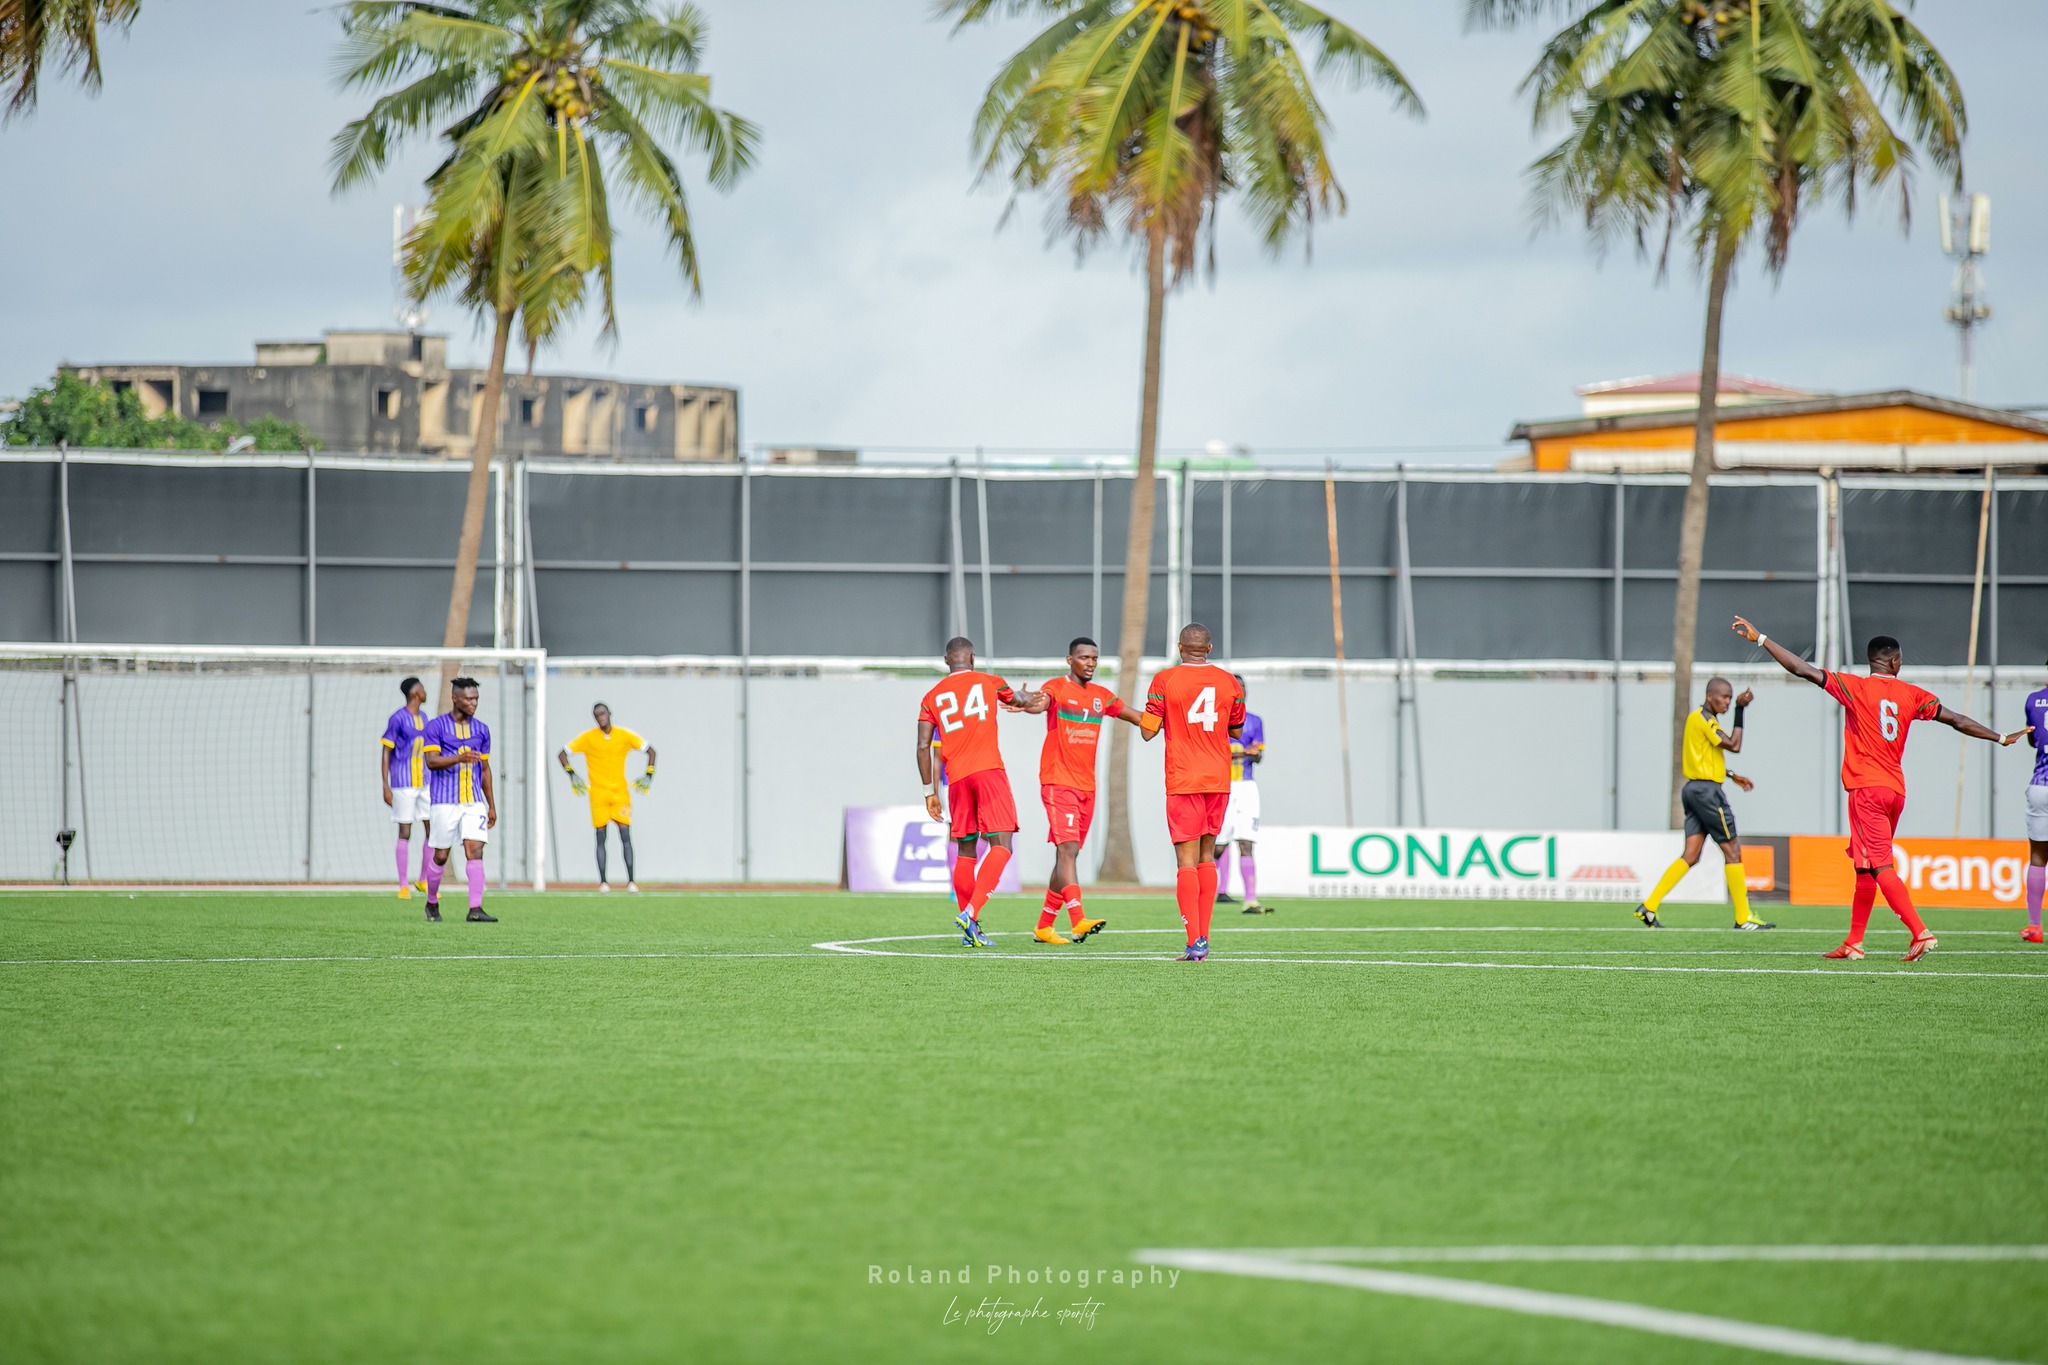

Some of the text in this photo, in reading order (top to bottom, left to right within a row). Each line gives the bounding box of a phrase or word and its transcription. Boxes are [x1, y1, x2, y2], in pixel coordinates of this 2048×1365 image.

[935, 683, 990, 734] 24
[1082, 708, 1089, 722] 7
[1187, 687, 1219, 732] 4
[1878, 698, 1899, 742] 6
[1065, 813, 1075, 827] 7
[1310, 833, 1557, 879] LONACI
[1309, 883, 1378, 898] LOTERIE
[1385, 884, 1482, 900] NATIONALE
[1488, 886, 1511, 900] DE
